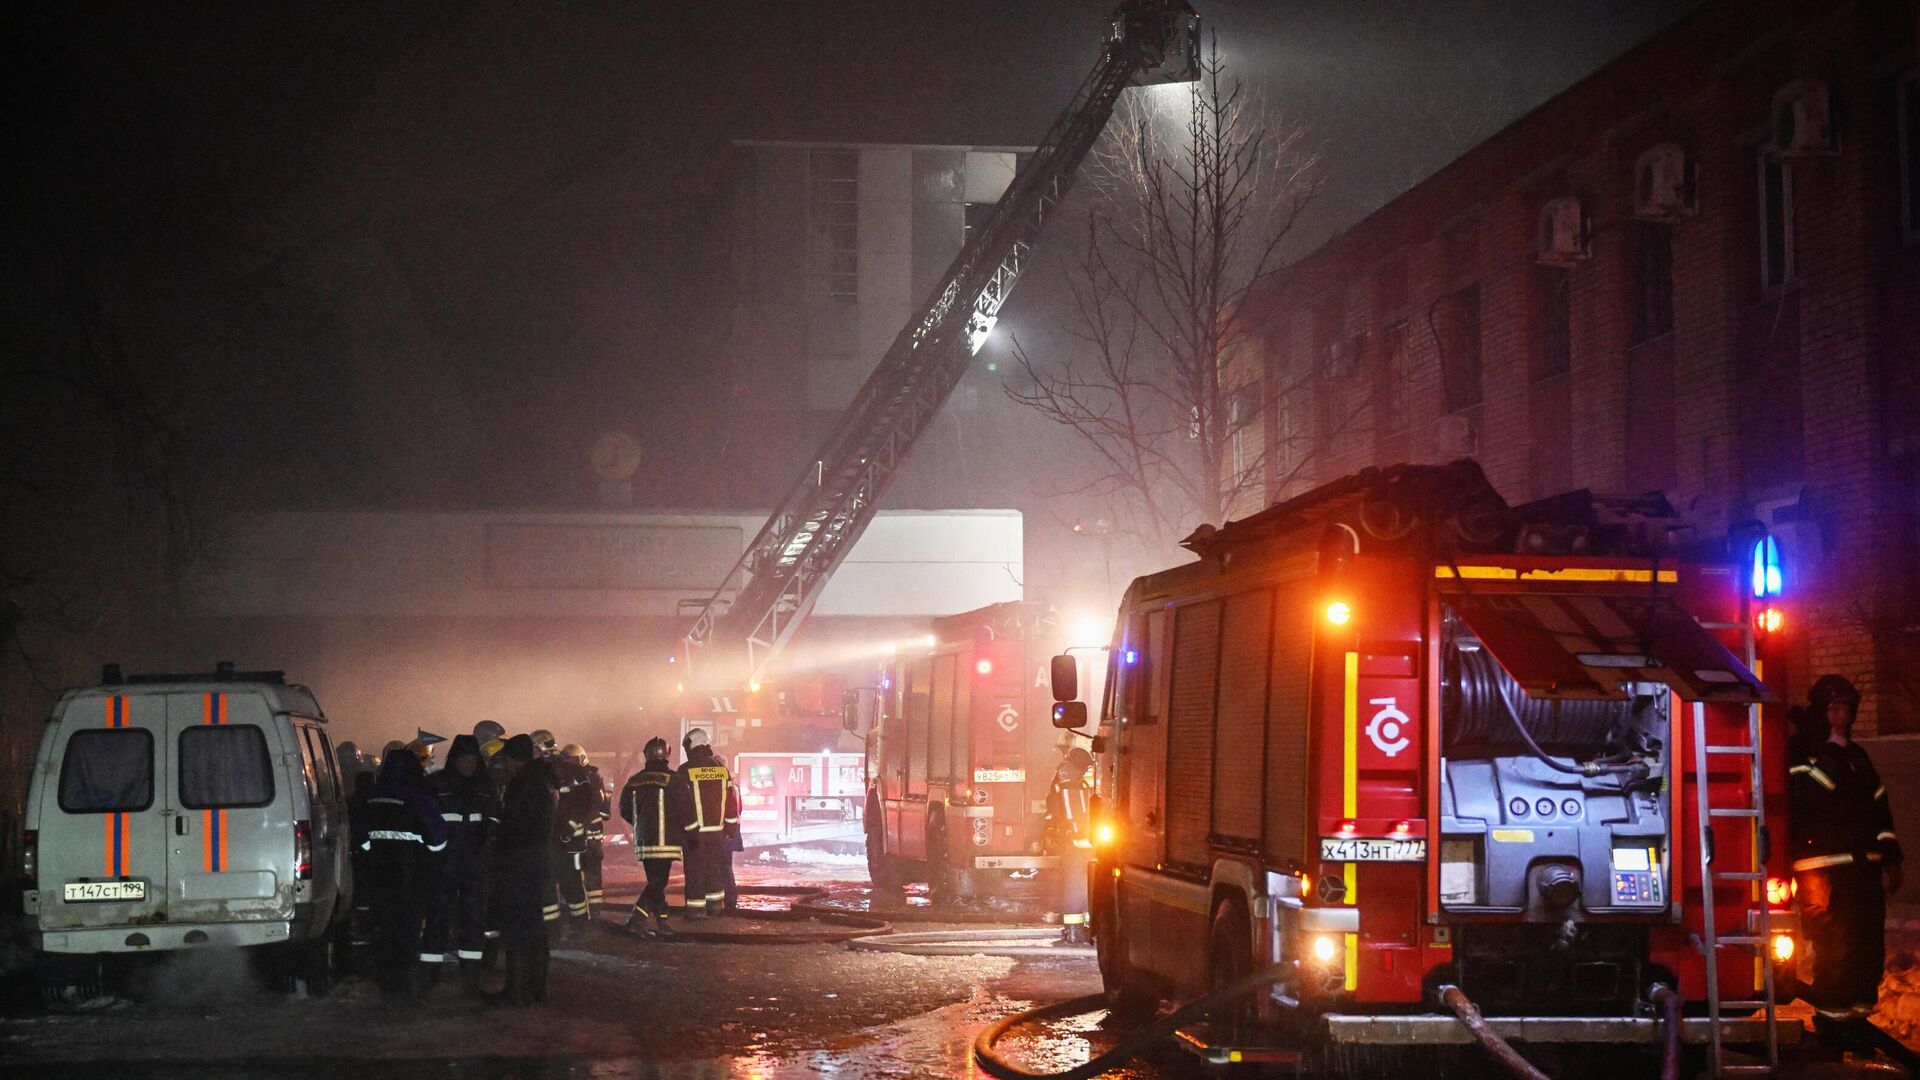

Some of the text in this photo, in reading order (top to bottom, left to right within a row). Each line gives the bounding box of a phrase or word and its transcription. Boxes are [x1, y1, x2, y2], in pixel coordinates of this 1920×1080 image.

[787, 767, 803, 784] АЛ
[1325, 840, 1421, 859] Х413НТ 777
[70, 883, 141, 898] Т147СТ 199
